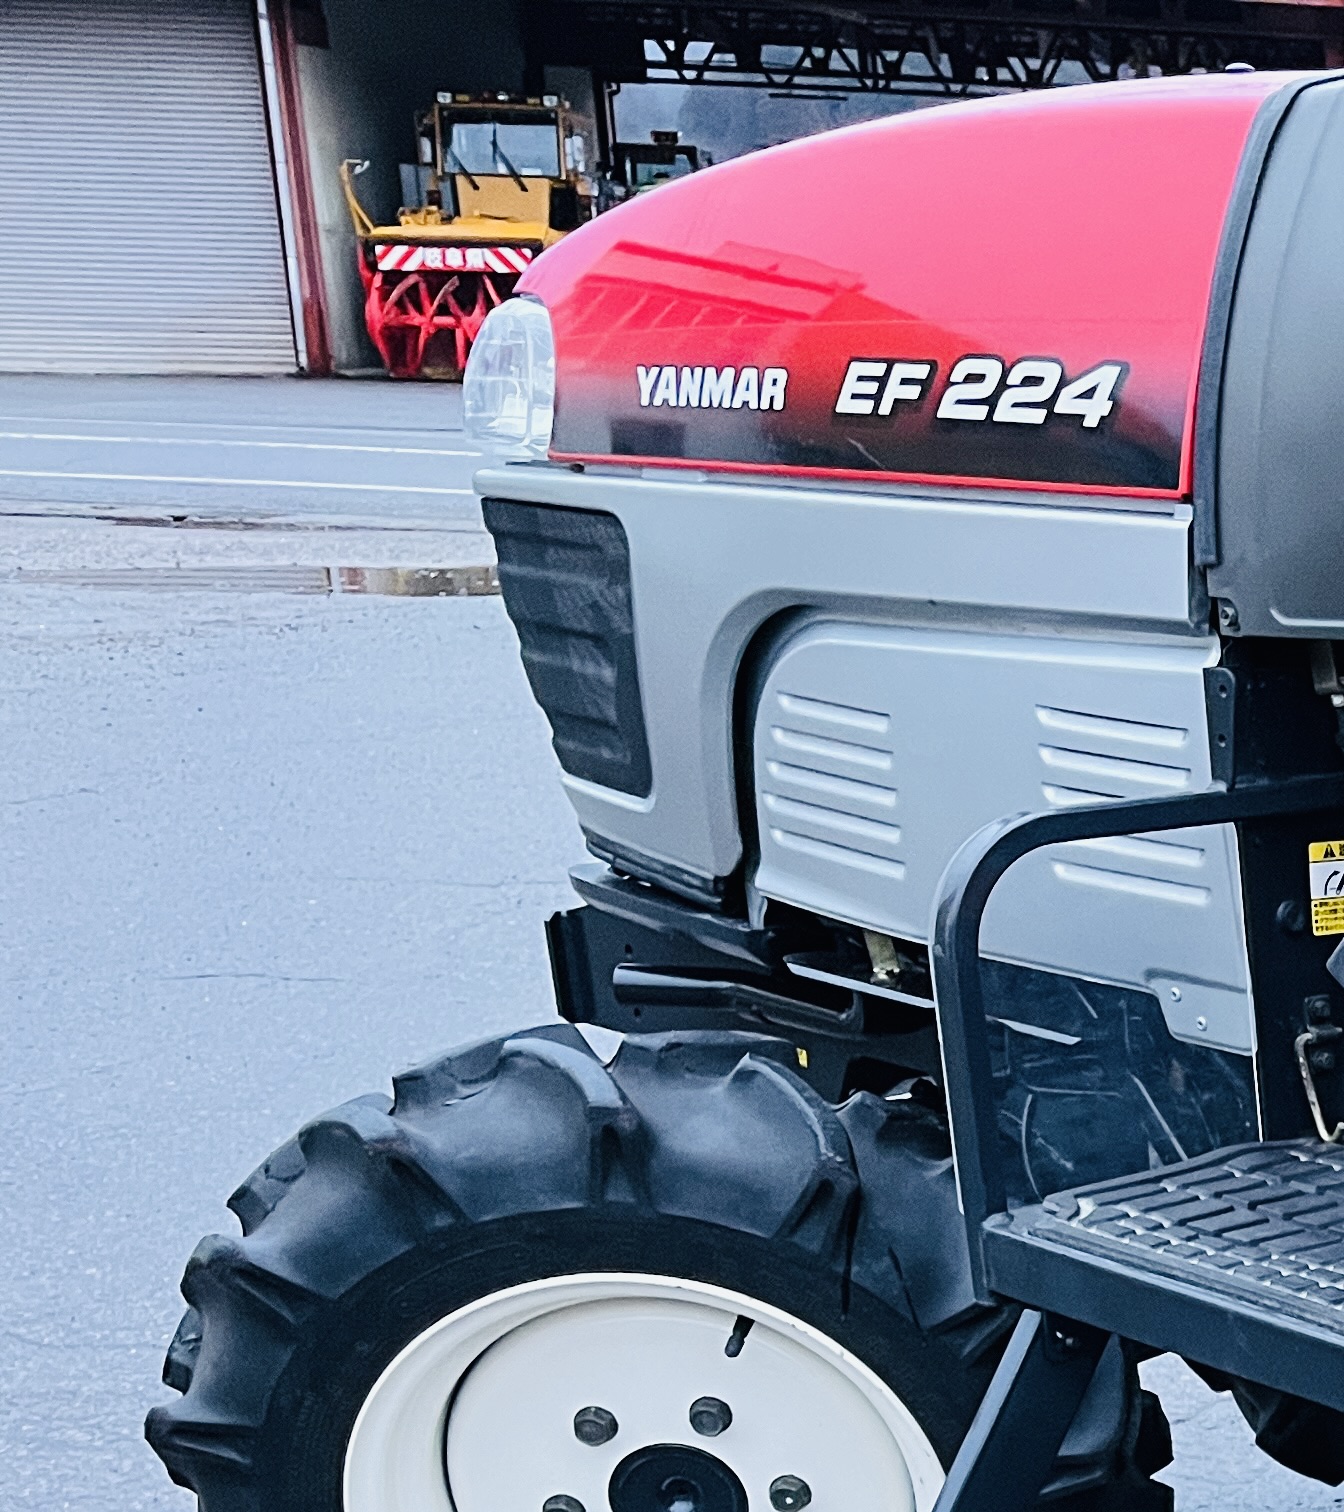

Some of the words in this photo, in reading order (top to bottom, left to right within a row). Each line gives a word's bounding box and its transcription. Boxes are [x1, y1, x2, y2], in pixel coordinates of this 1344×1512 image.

[636, 365, 788, 411] YANMAR
[835, 361, 927, 416] EF
[936, 358, 1122, 428] 224
